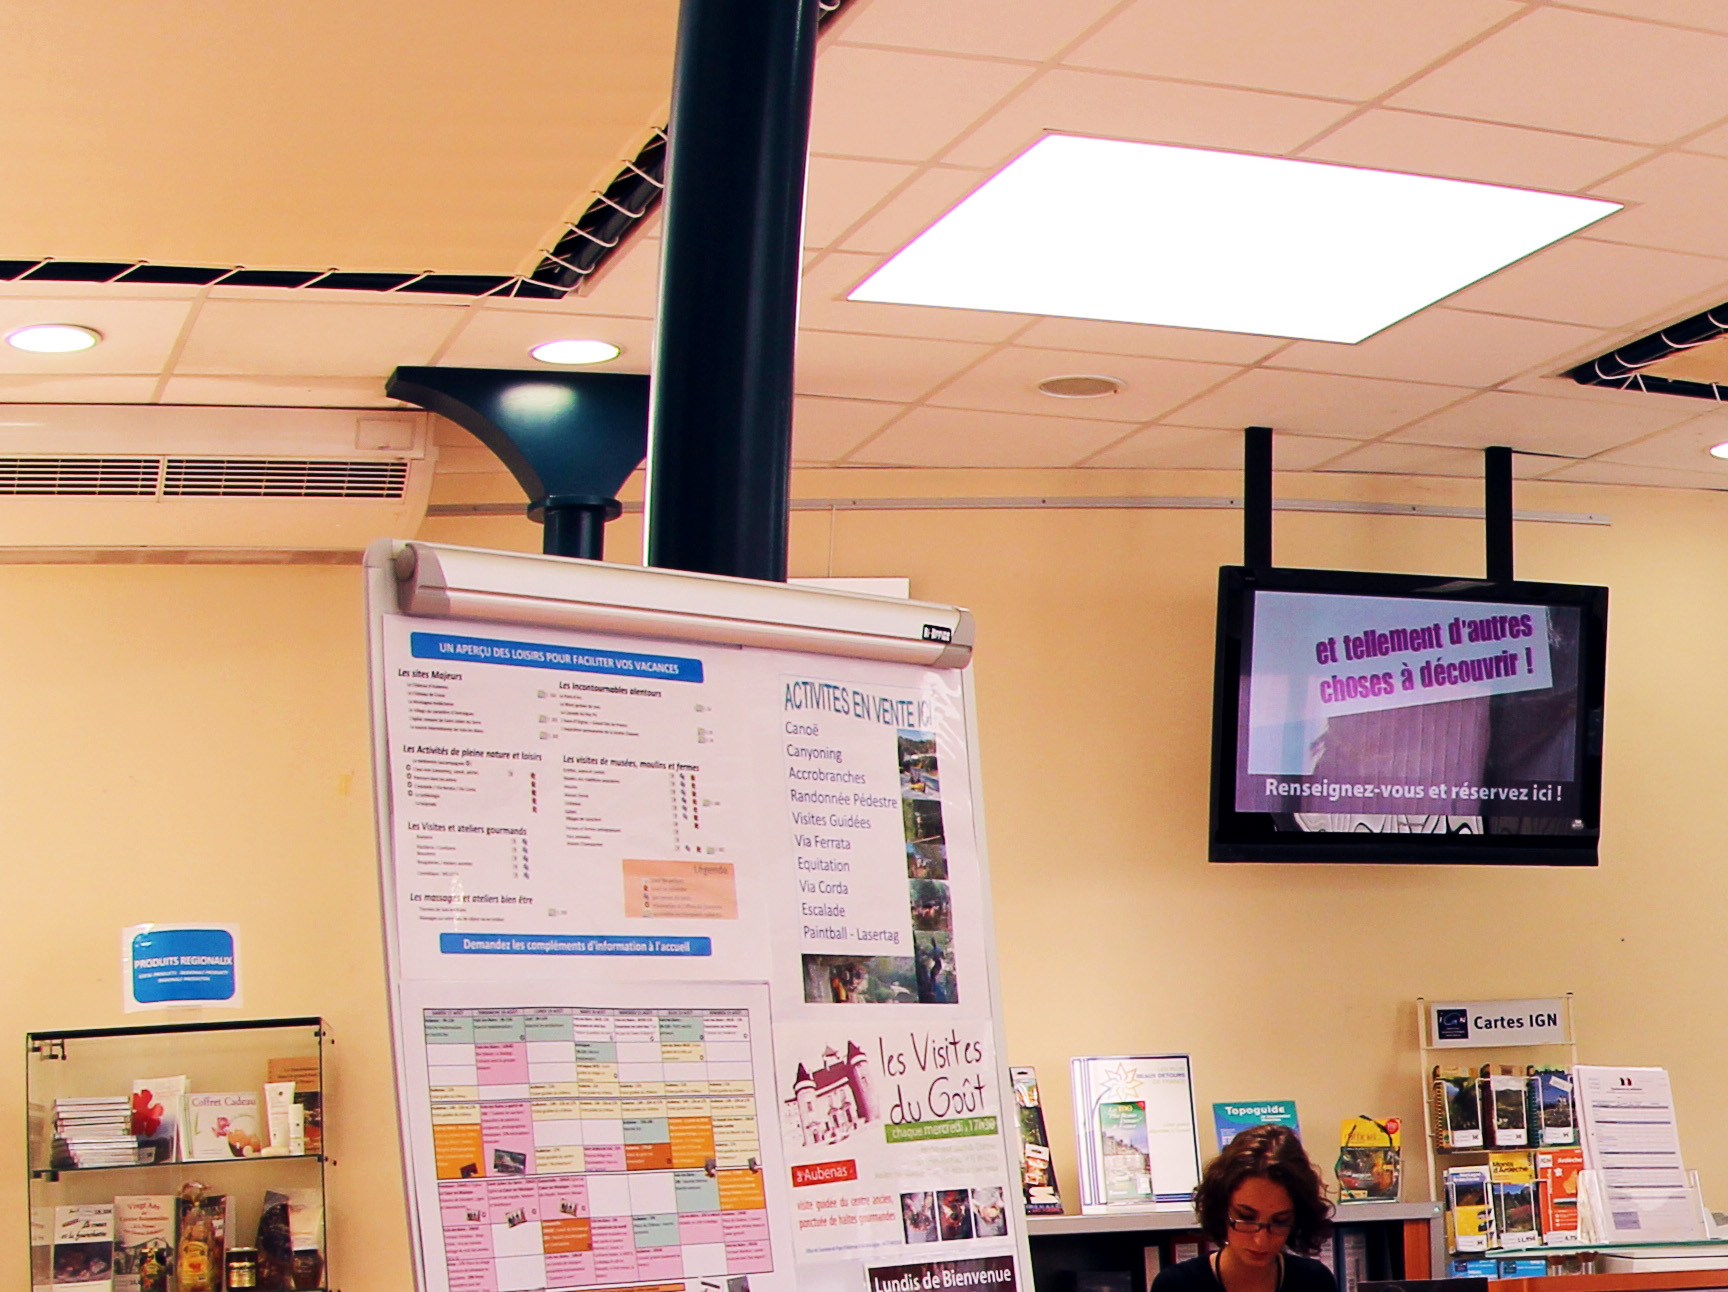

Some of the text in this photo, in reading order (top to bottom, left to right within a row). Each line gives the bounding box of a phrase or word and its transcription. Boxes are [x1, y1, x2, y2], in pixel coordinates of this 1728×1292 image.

[1316, 614, 1533, 664] et tellement d'autres
[440, 643, 680, 674] UN APERÇU DES LOISIRS POUR FACILITER VOS VACANCES
[398, 669, 462, 681] Les sites Majeurs
[1320, 650, 1518, 703] choses à découvrir
[559, 682, 570, 690] Les
[784, 681, 850, 715] ACTIVITES
[852, 691, 871, 720] EN
[873, 696, 915, 727] VENTE
[785, 721, 819, 736] Canoë
[403, 745, 415, 753] Les
[417, 745, 448, 756] Activités
[462, 748, 484, 758] pleine
[486, 751, 510, 759] nature
[521, 751, 542, 761] loisirs
[786, 744, 843, 763] Canyoning
[563, 755, 574, 763] Les
[576, 756, 598, 765] visites
[600, 757, 608, 765] de
[676, 762, 699, 772] fermes
[789, 767, 866, 785] Accrobranches
[1266, 779, 1552, 801] Renseignez-vous et réservez ici
[790, 789, 897, 809] Randonnée Pédestre
[792, 812, 871, 829] Visites Guidées
[408, 822, 420, 830] Les
[422, 823, 446, 832] Visites
[457, 825, 484, 833] ateliers
[486, 827, 527, 836] gourmands
[794, 834, 851, 850] Via Ferrata
[797, 857, 850, 872] Equitation
[799, 880, 848, 894] Via Corda
[410, 893, 421, 901] Les
[802, 902, 845, 917] Escalade
[803, 926, 900, 944] Paintball Lasertag
[463, 939, 511, 951] Demandez
[512, 939, 525, 950] les
[527, 940, 585, 952] compléments
[587, 940, 647, 951] d'information
[655, 941, 691, 952] l'accueil
[134, 955, 233, 969] PRODUITS REGIONAUX
[1474, 1013, 1557, 1029] Cartes IGN
[879, 1029, 982, 1077] les Visites
[224, 1095, 256, 1106] Cadeau
[890, 1074, 986, 1125] du Goût
[1225, 1105, 1285, 1116] Topoguide
[804, 1166, 848, 1181] Aubenas
[922, 1270, 941, 1289] de
[942, 1268, 1012, 1288] Bienvenue
